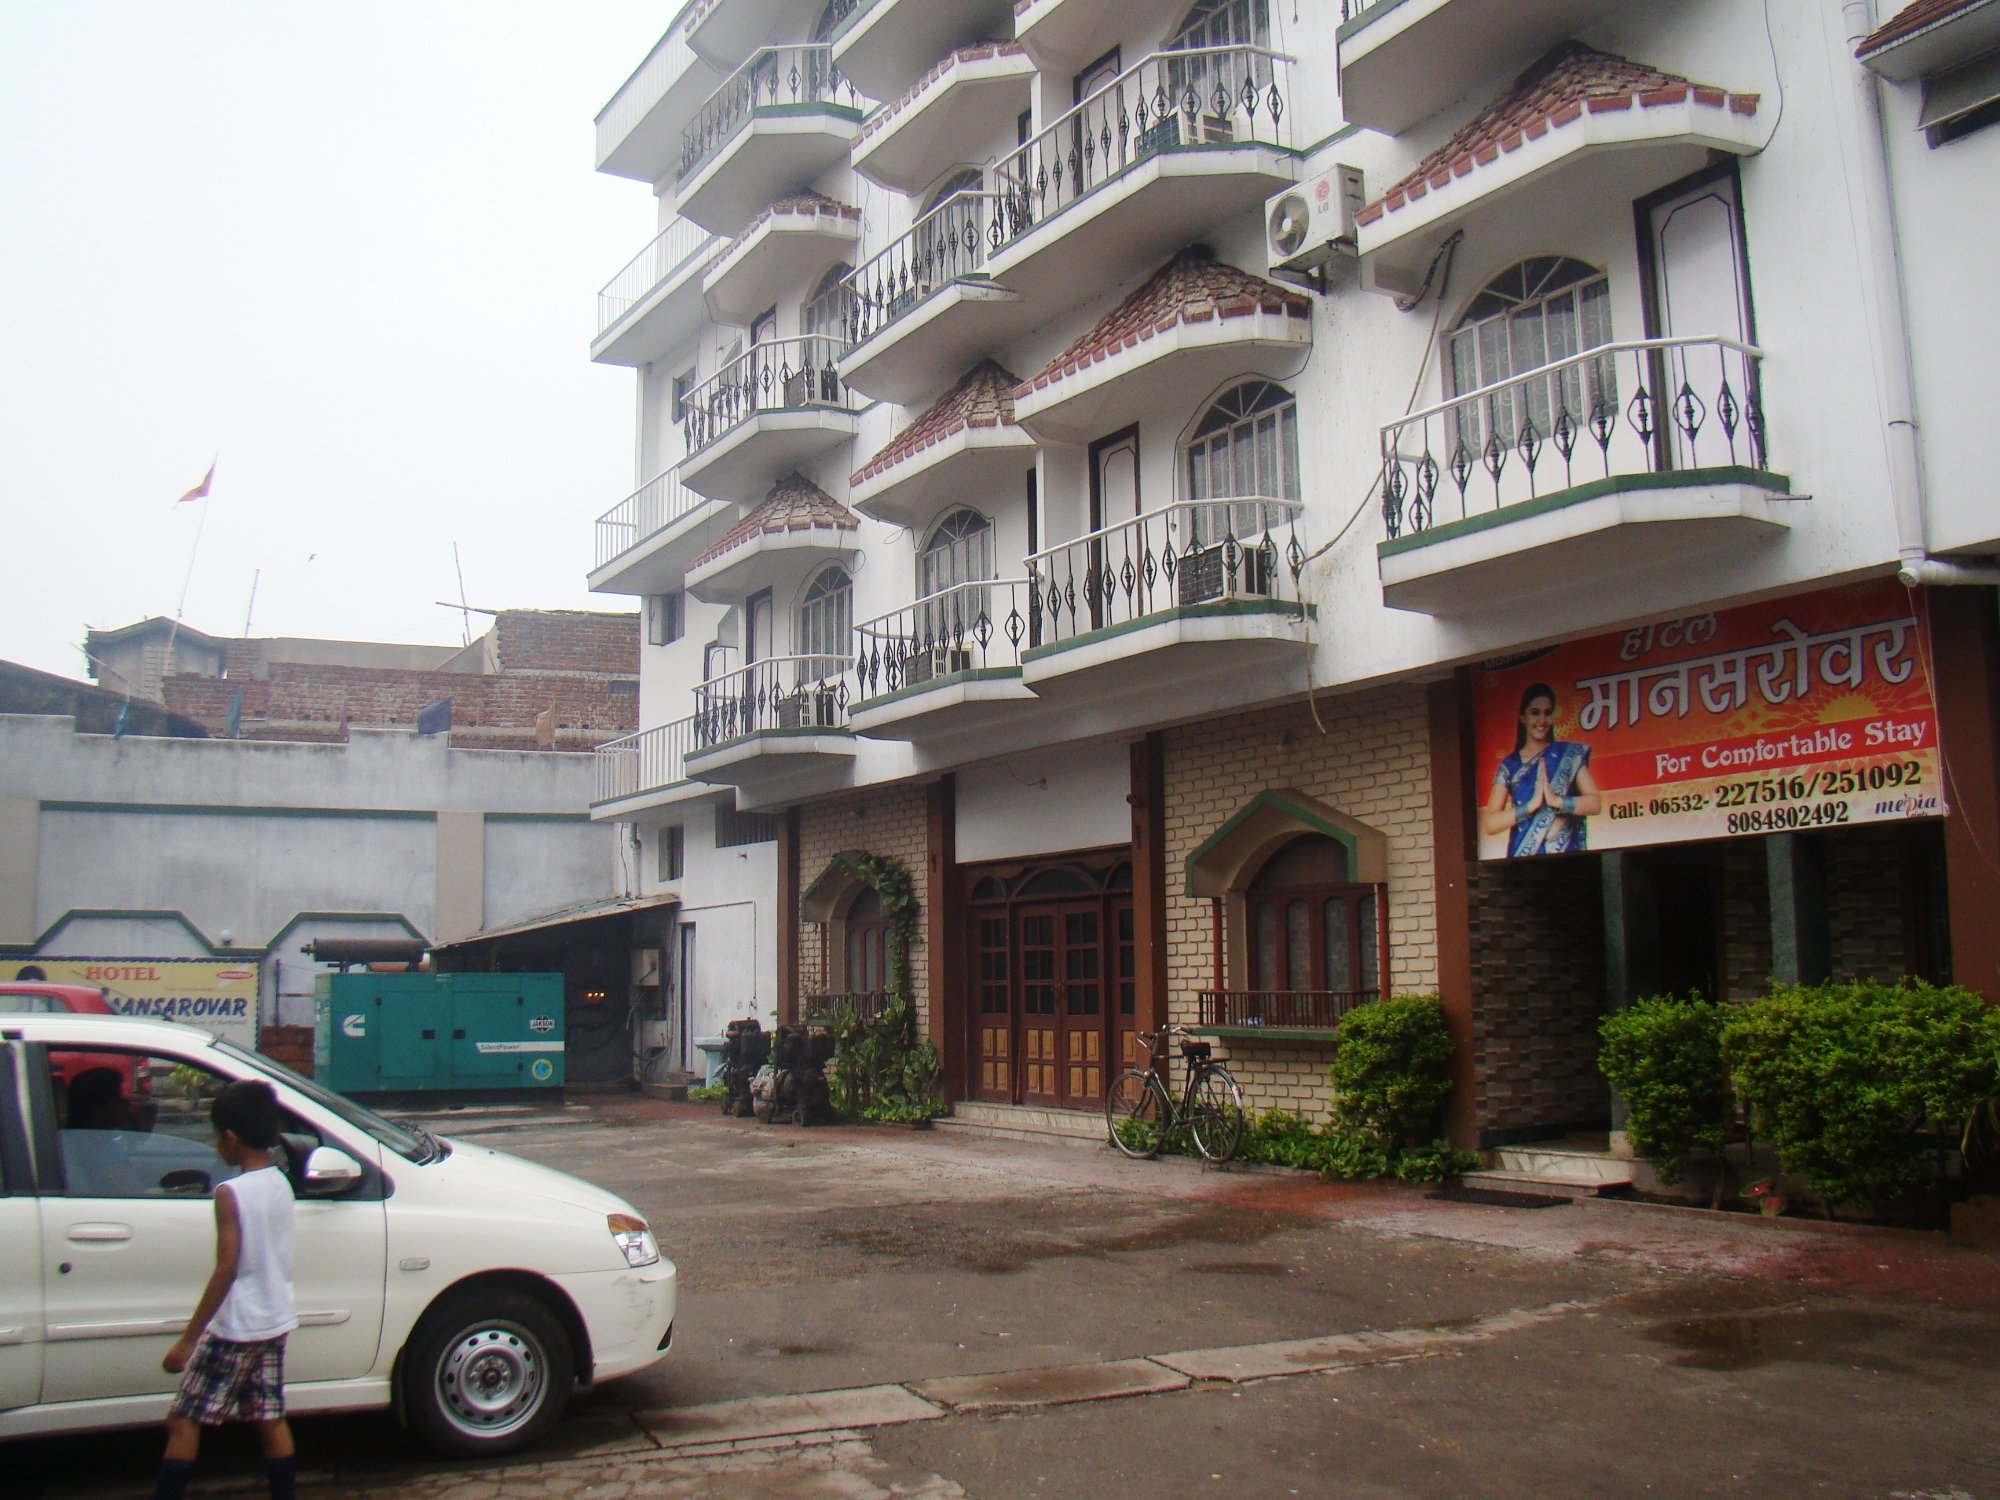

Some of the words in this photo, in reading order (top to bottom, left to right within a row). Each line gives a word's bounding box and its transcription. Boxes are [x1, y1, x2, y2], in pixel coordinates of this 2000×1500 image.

[1318, 202, 1329, 214] LG
[1576, 617, 1919, 731] मानसरोवर
[1655, 753, 1691, 779] For
[1701, 729, 1852, 768] Comfortable
[1864, 720, 1926, 747] Stay
[1609, 801, 1644, 819] Call:
[1649, 794, 1709, 815] 06532-
[1715, 761, 1921, 808] 227516/251092
[1727, 801, 1849, 834] 8084802492
[85, 966, 160, 981] HOTEL
